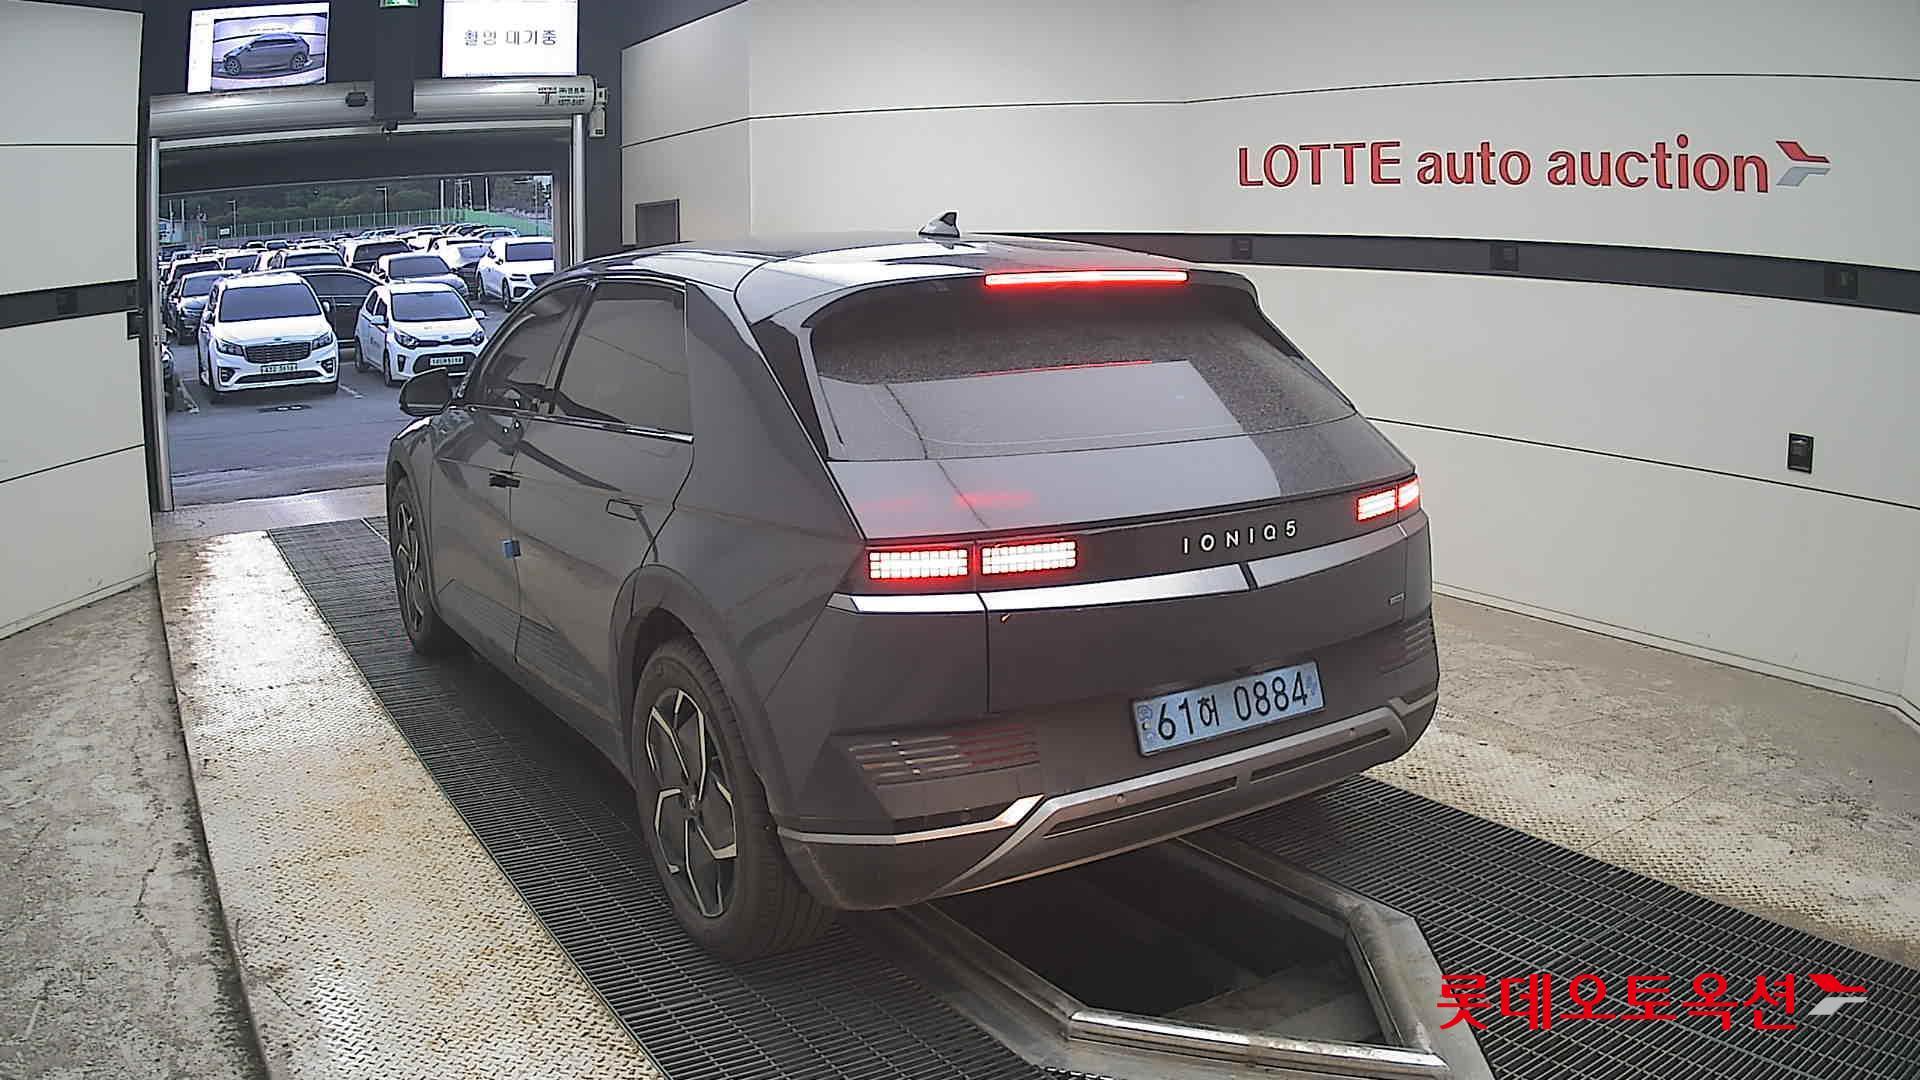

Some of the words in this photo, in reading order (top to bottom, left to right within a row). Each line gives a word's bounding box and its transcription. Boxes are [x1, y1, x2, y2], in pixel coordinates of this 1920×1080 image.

[505, 29, 557, 46] 대기중
[1239, 141, 1400, 188] LOTTE
[1417, 141, 1531, 187] auto
[1546, 134, 1769, 193] auction
[1157, 694, 1220, 741] 61허
[1232, 671, 1308, 721] 0884
